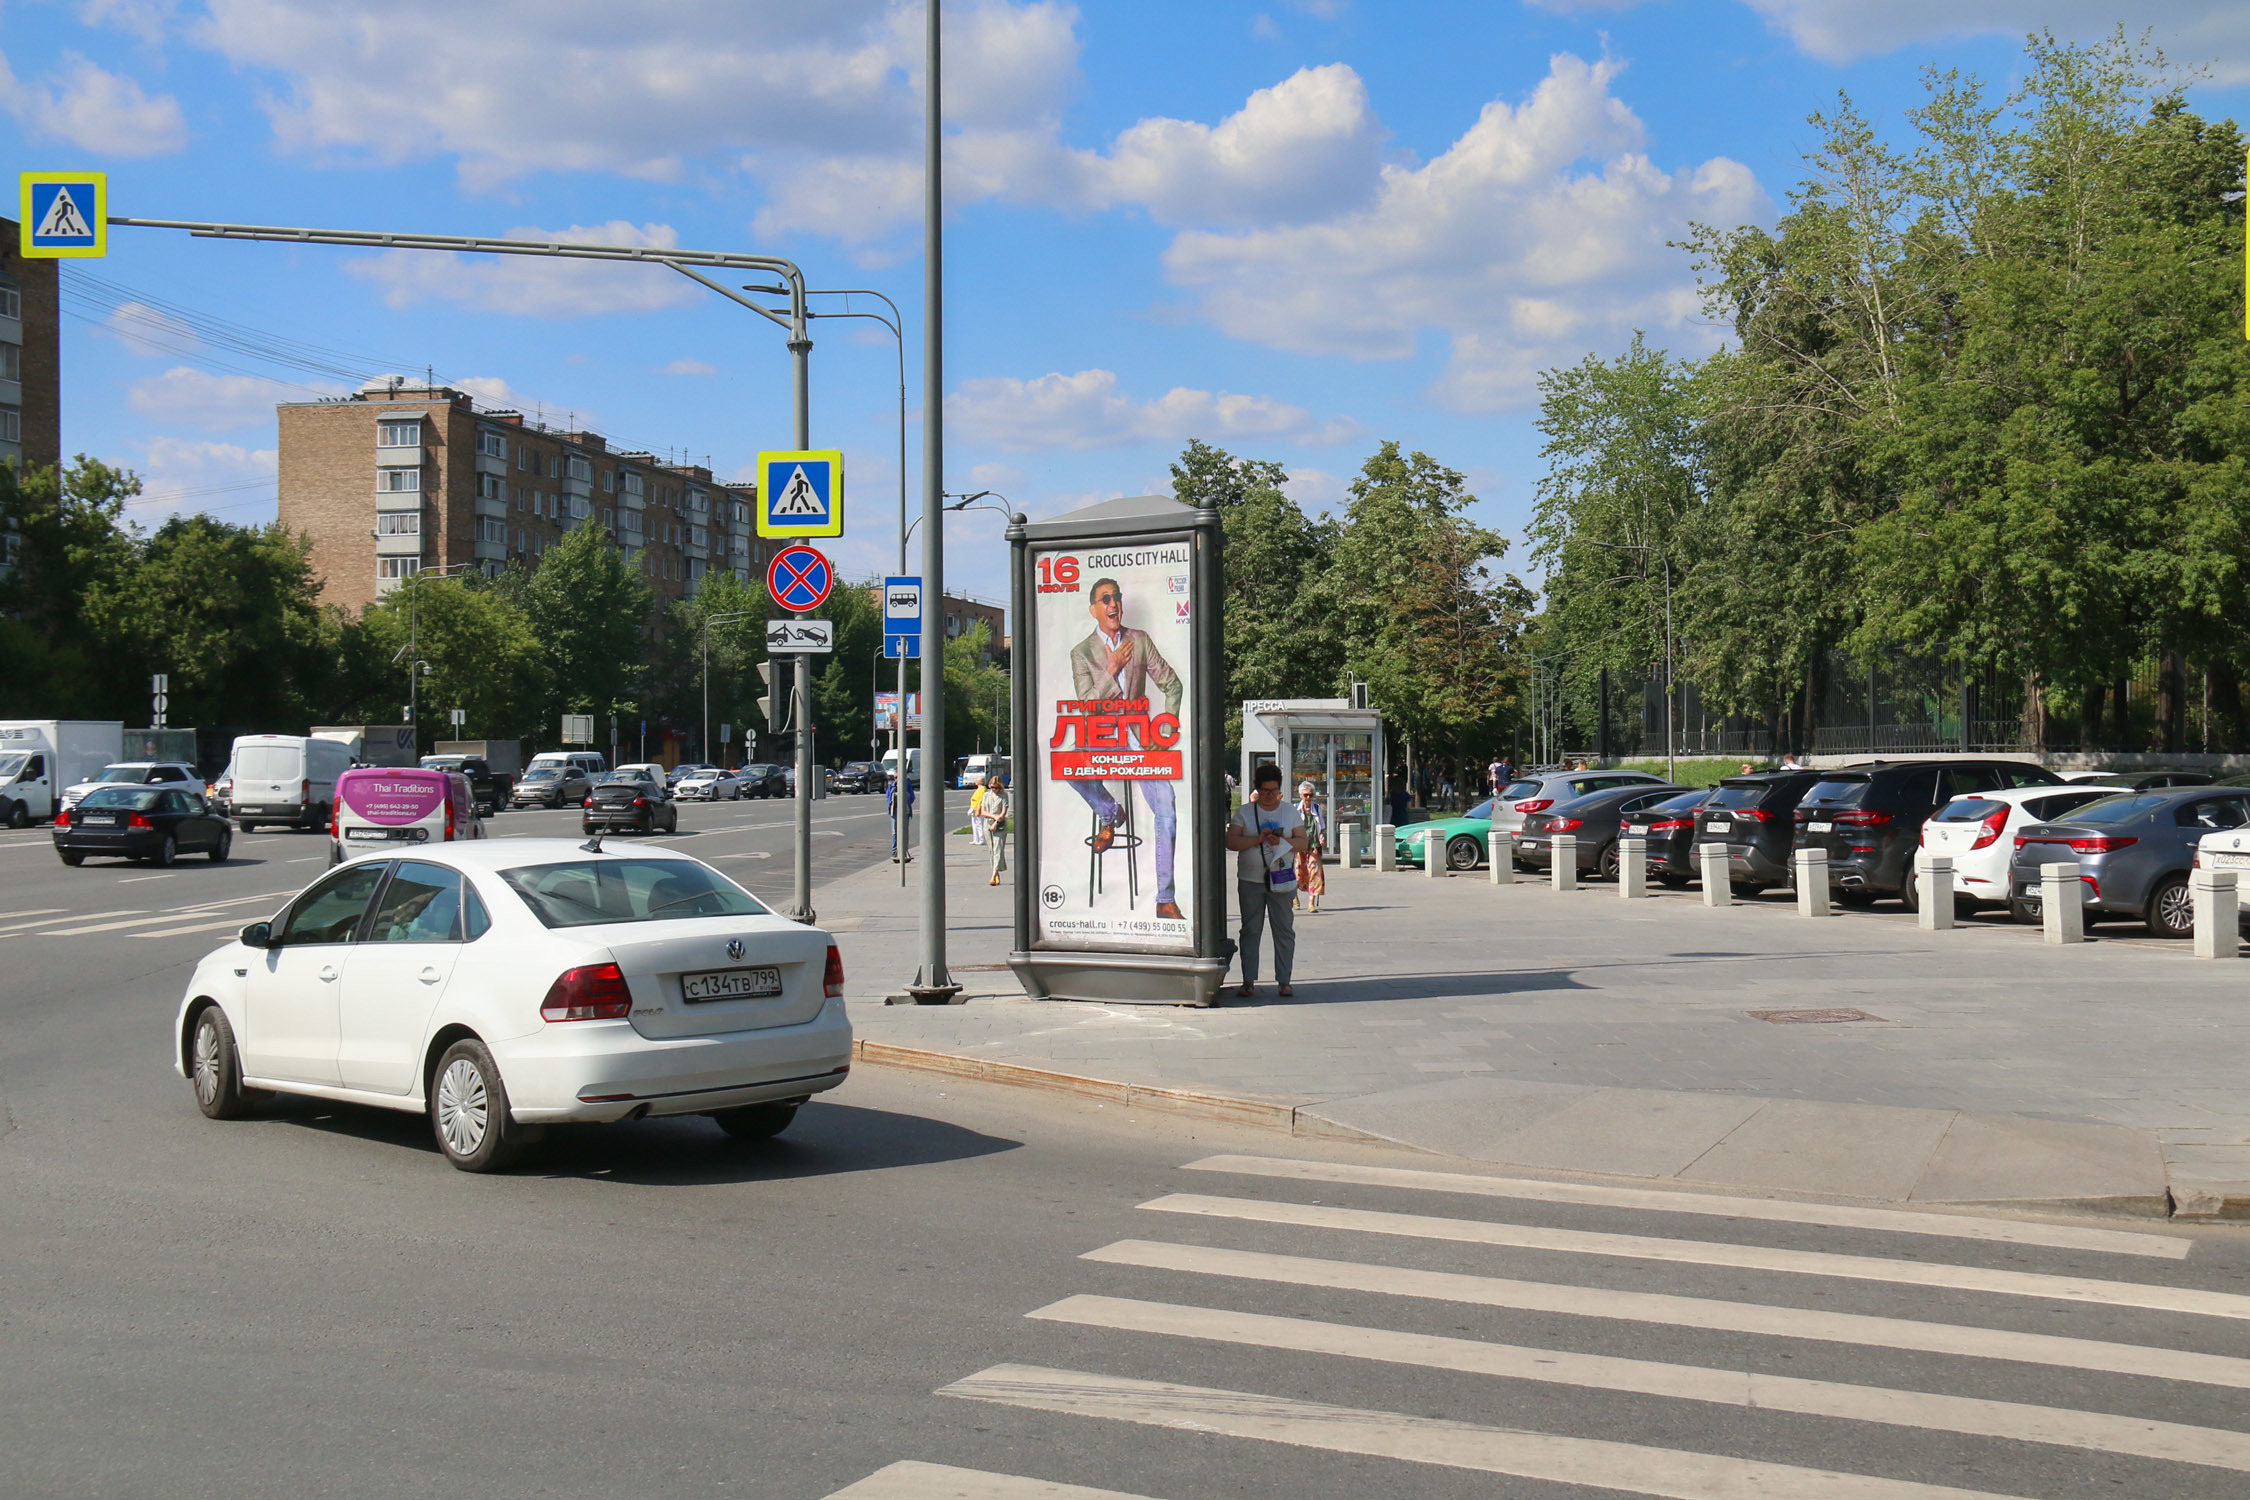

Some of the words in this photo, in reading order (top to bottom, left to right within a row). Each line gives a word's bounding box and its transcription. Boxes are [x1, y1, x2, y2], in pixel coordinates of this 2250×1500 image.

[1088, 553, 1134, 569] CROCUS
[1135, 551, 1159, 566] CITY
[1160, 549, 1189, 563] HALL
[1037, 556, 1080, 584] 16
[1038, 583, 1080, 593] ИЮЛЯ
[1056, 696, 1150, 713] ГРИГОРИЙ
[1242, 701, 1285, 713] ПРЕССА
[1050, 713, 1181, 749] ЛЕПС
[1091, 754, 1145, 765] КОНЦЕРТ
[1063, 767, 1073, 776] В
[1075, 766, 1108, 777] ДЕНЬ
[1109, 766, 1173, 776] РОЖДЕНИЯ
[373, 783, 391, 793] Thai
[393, 783, 434, 794] Traditions
[1044, 891, 1063, 903] 18+
[1049, 920, 1107, 929] crocus-hall.ru
[1117, 920, 1128, 929] +7
[1129, 921, 1151, 932] (499)
[1152, 922, 1161, 931] 55
[1162, 923, 1176, 932] 000
[1177, 923, 1187, 933] 55
